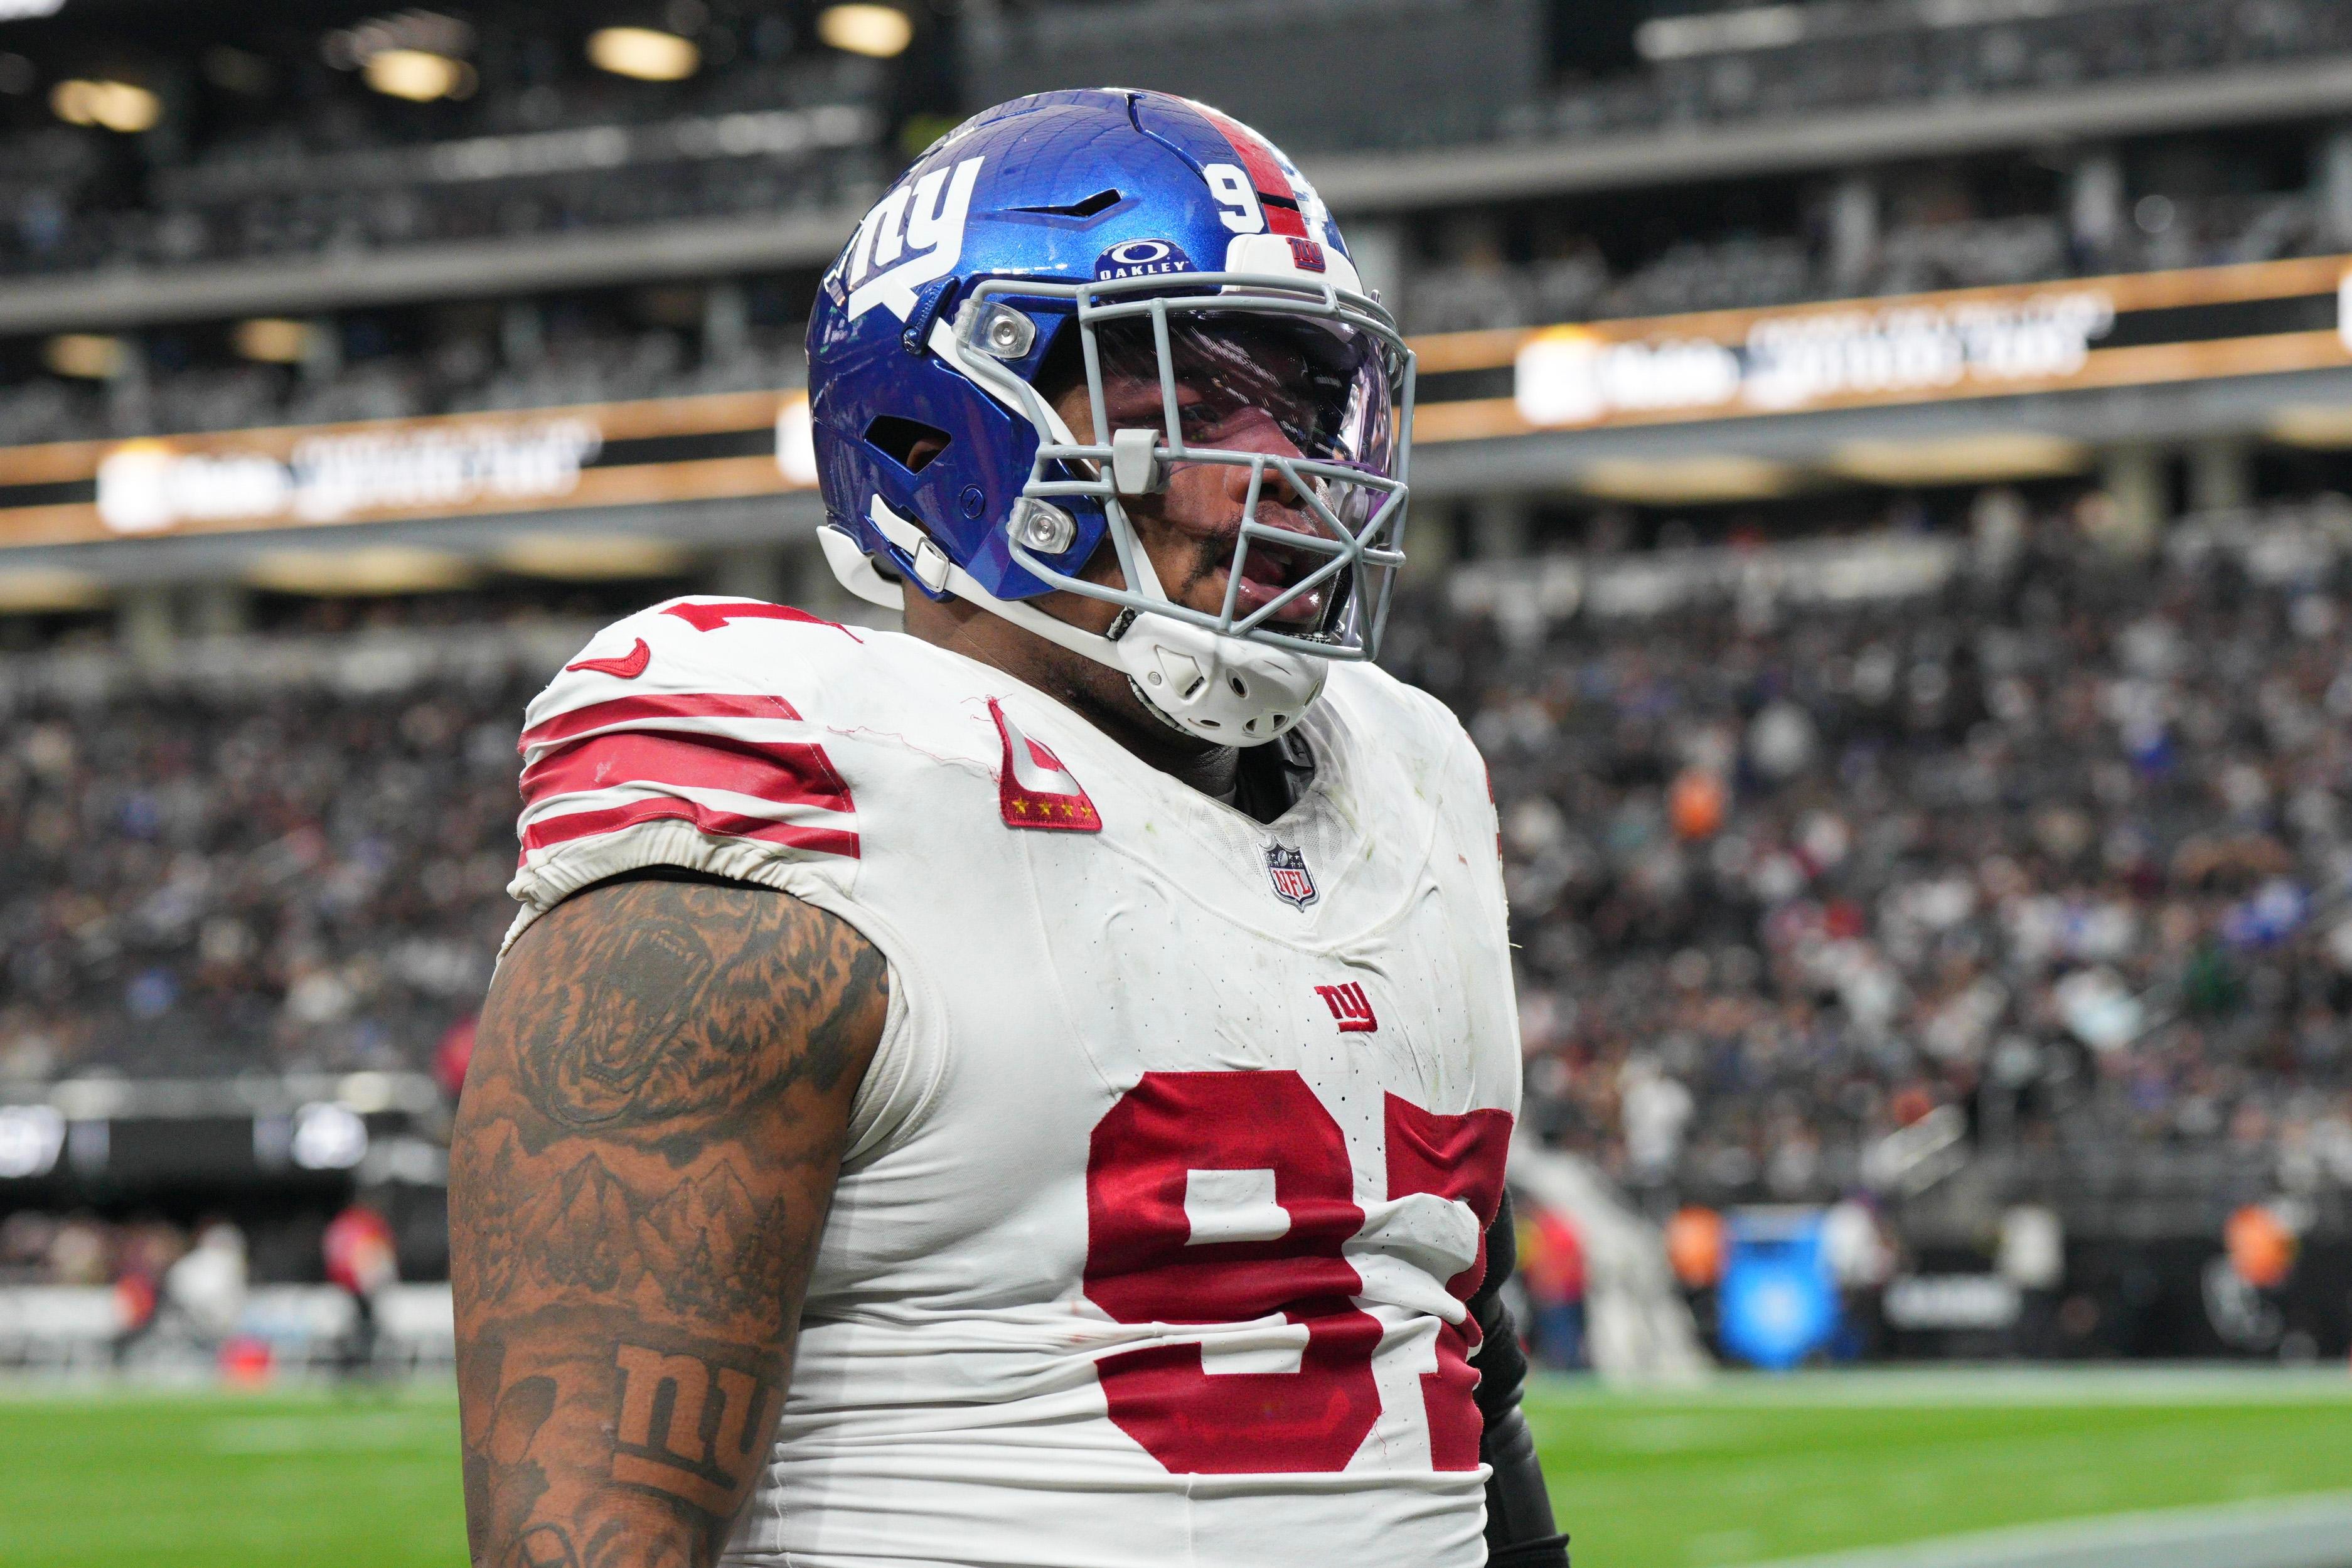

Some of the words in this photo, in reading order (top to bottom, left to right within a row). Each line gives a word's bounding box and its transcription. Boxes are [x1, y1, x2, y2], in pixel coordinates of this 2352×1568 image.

[1203, 164, 1264, 233] 9
[1099, 261, 1186, 280] OAKLEY
[1273, 868, 1312, 898] NFL
